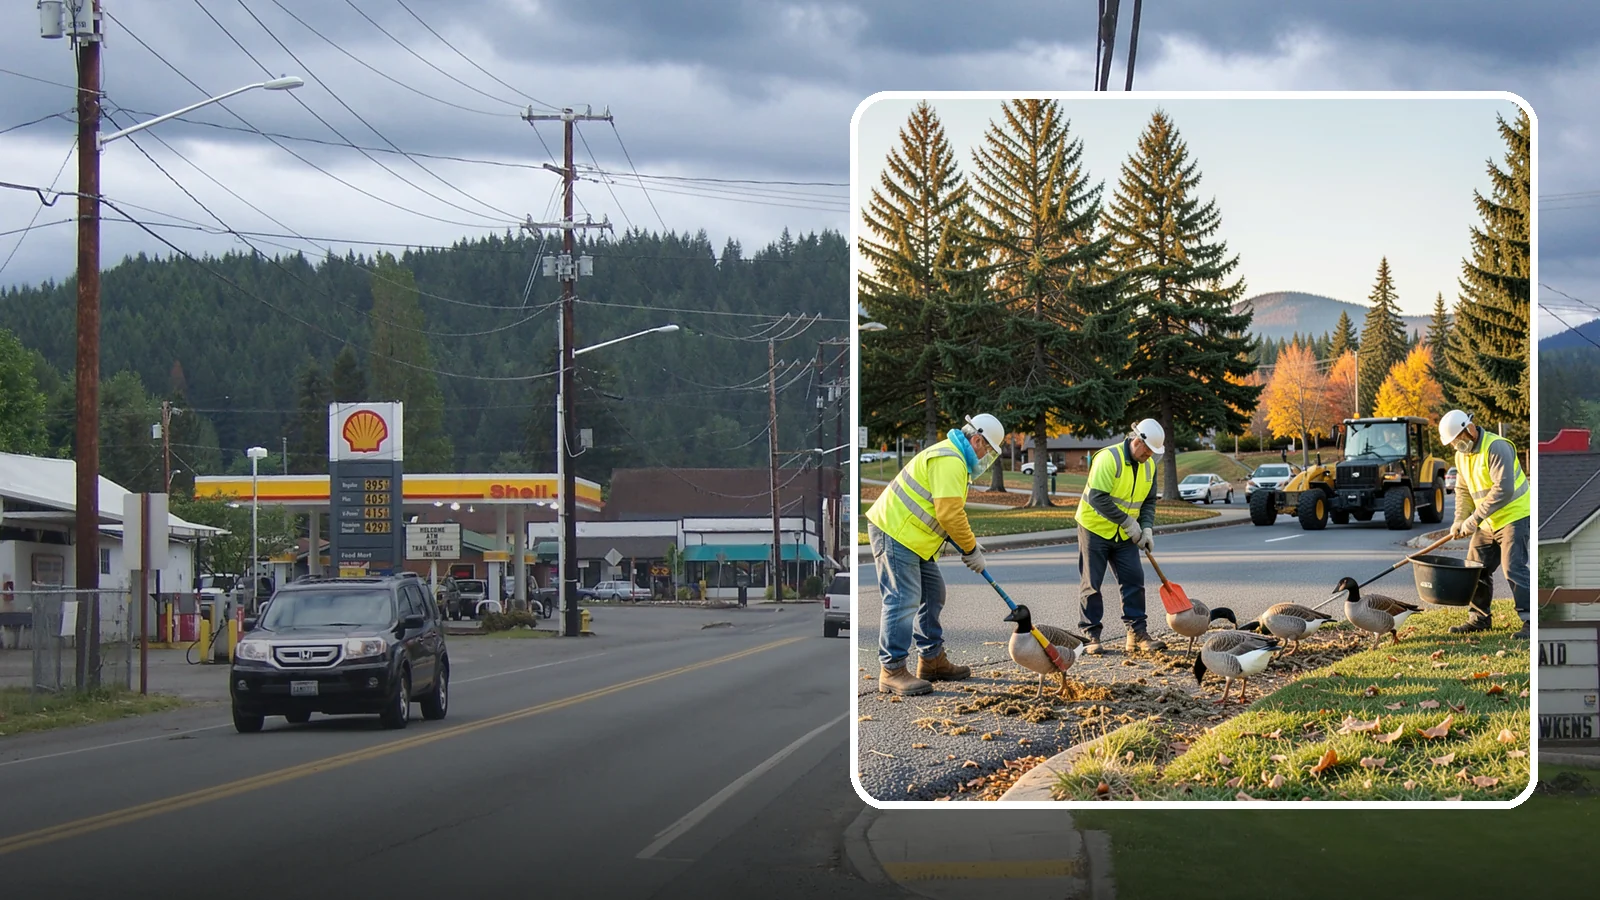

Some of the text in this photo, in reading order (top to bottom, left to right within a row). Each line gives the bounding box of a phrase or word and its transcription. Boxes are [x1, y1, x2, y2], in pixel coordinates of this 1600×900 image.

[366, 480, 383, 490] 395
[490, 484, 547, 499] Shell
[366, 494, 383, 504] 405
[366, 508, 383, 518] 415
[366, 522, 383, 532] 429
[1538, 643, 1566, 665] AID
